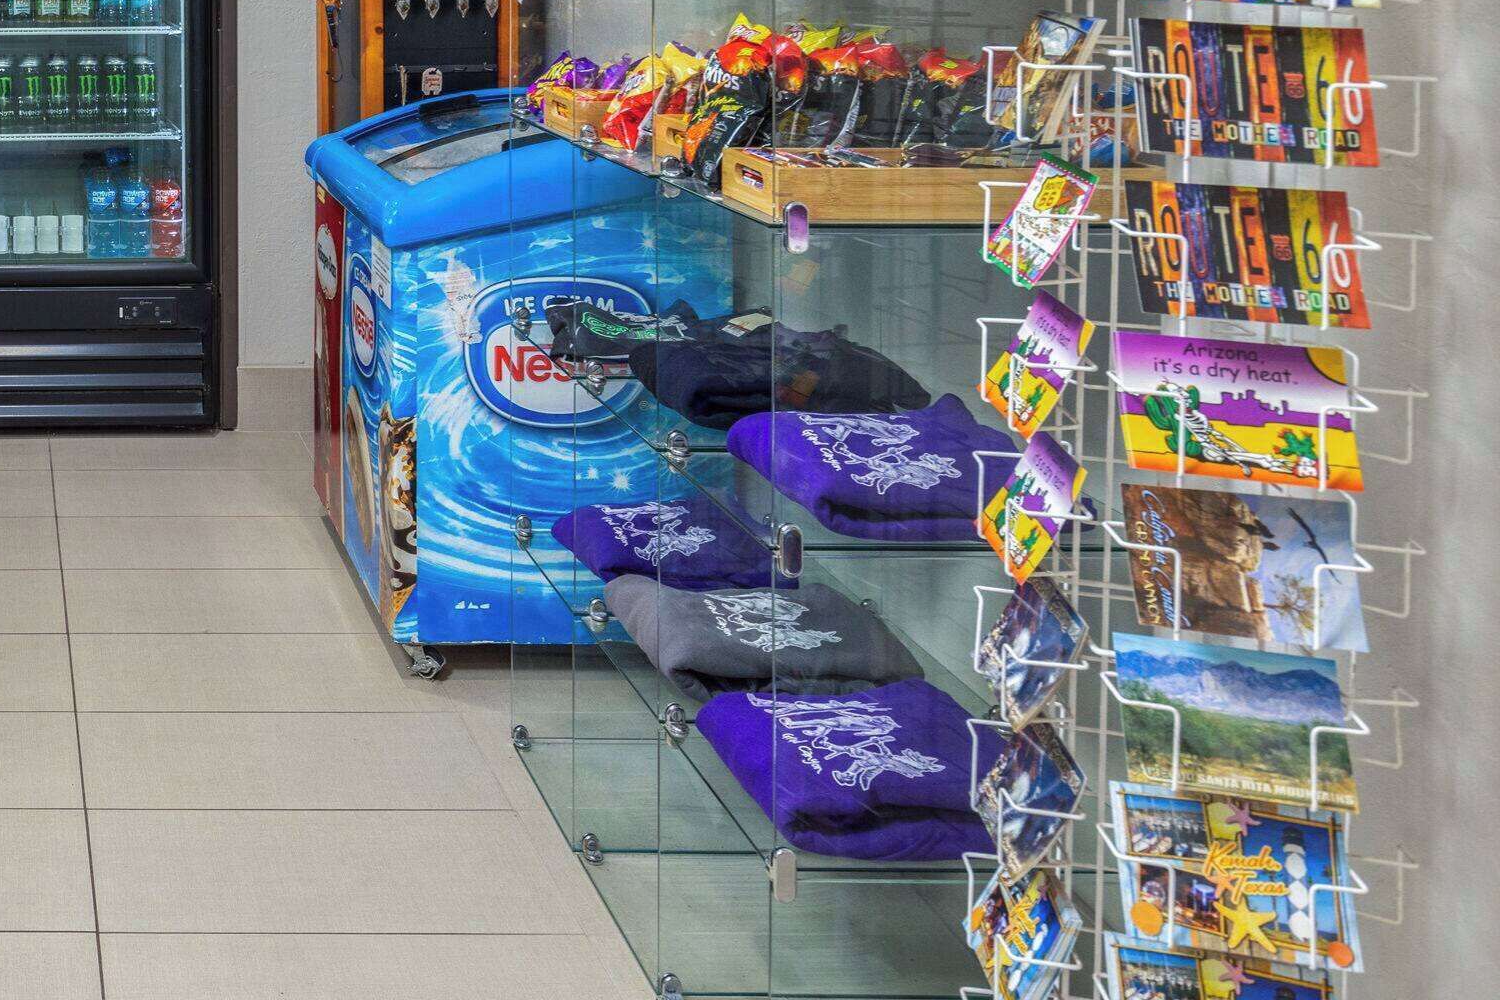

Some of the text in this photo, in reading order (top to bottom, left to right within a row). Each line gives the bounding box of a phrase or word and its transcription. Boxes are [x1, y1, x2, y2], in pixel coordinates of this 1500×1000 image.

[1148, 42, 1364, 126] ROUTE 66
[1212, 120, 1296, 148] MOTHER
[1303, 127, 1362, 150] ROAD
[1134, 204, 1352, 288] ROUTE 66
[503, 296, 536, 316] ICE
[1204, 281, 1288, 309] MOTHER
[1183, 341, 1265, 363] Arizona,
[1153, 356, 1299, 385] it's a dry heat.
[1197, 775, 1239, 789] SANTA
[1241, 780, 1270, 792] RITA
[1229, 870, 1291, 904] Texas
